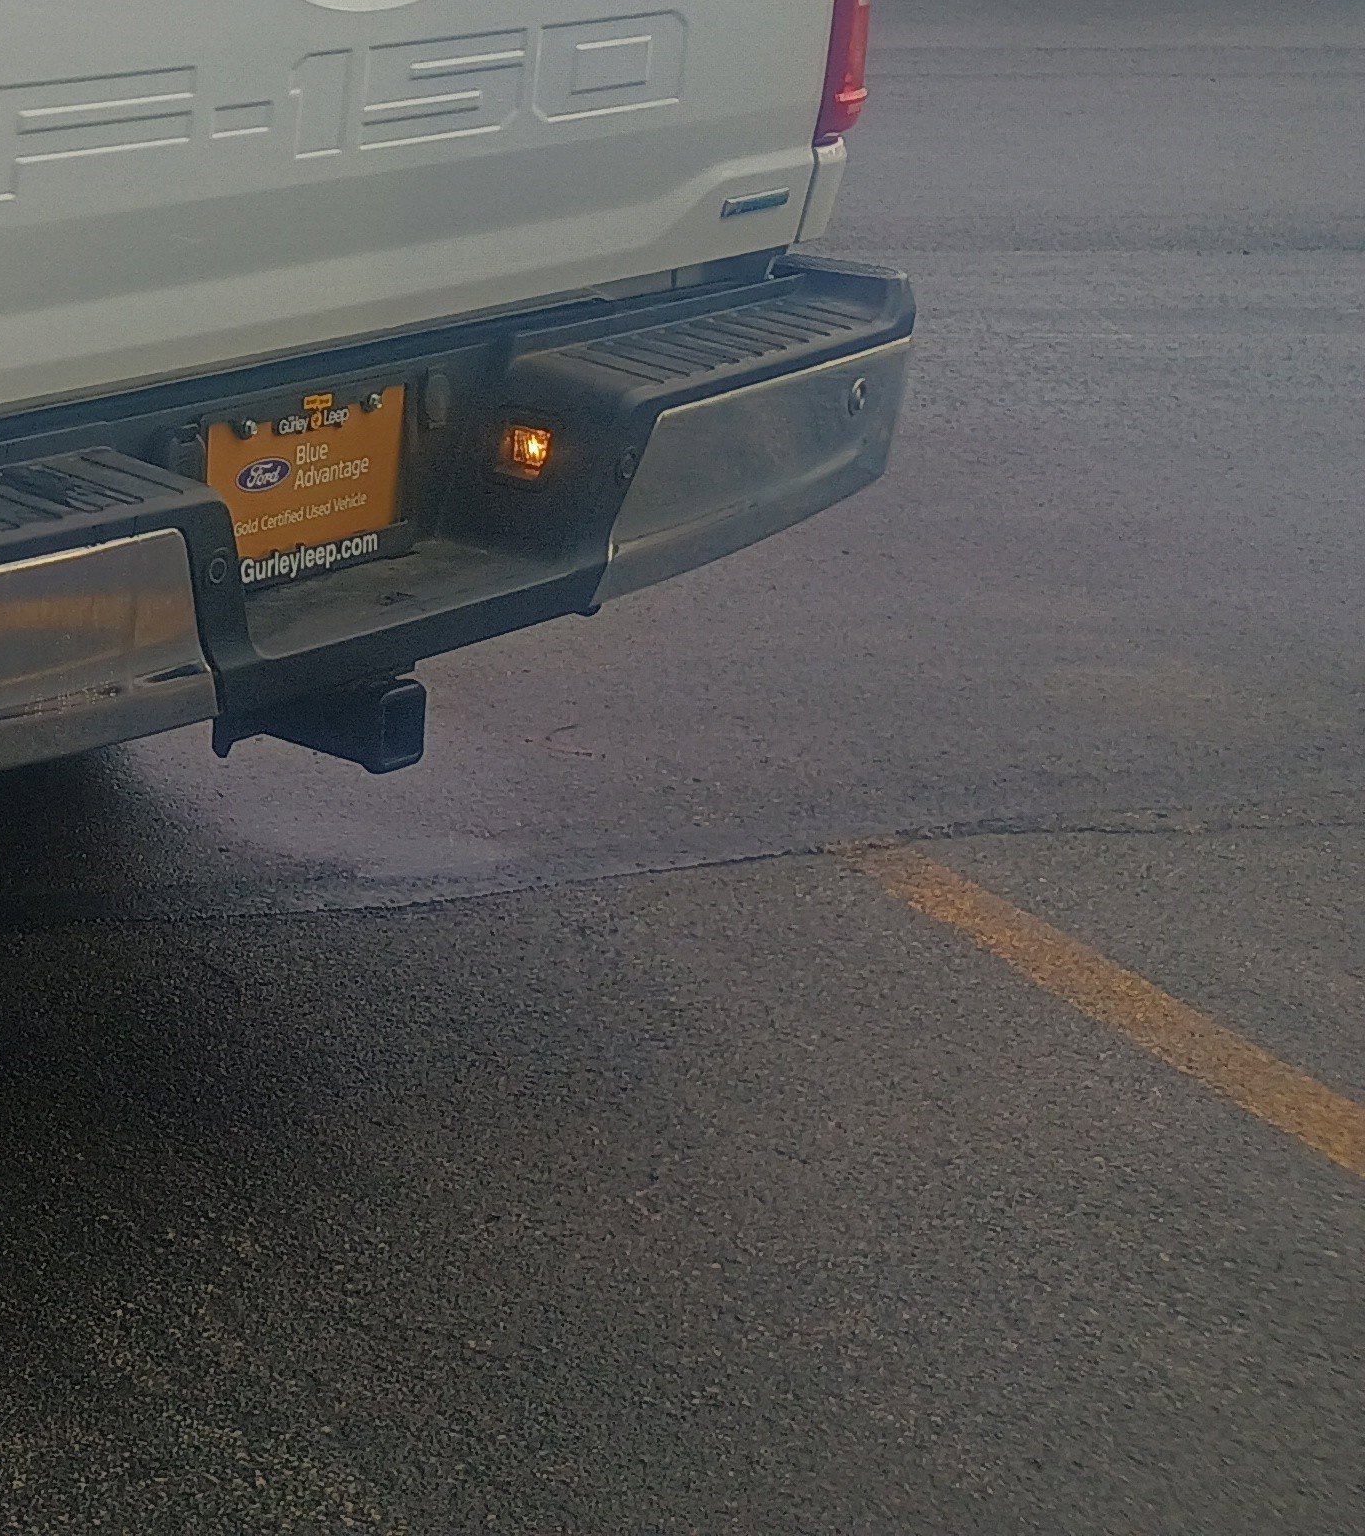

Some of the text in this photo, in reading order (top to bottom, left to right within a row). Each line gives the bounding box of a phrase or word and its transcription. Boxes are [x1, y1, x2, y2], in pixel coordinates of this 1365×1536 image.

[279, 408, 349, 435] Gurley Leep
[296, 443, 328, 464] Blue
[246, 462, 281, 487] Ford
[294, 457, 369, 490] Advantage
[234, 492, 367, 537] Gold Certified Used Vehicle
[241, 532, 378, 584] Gurleyleep.com
